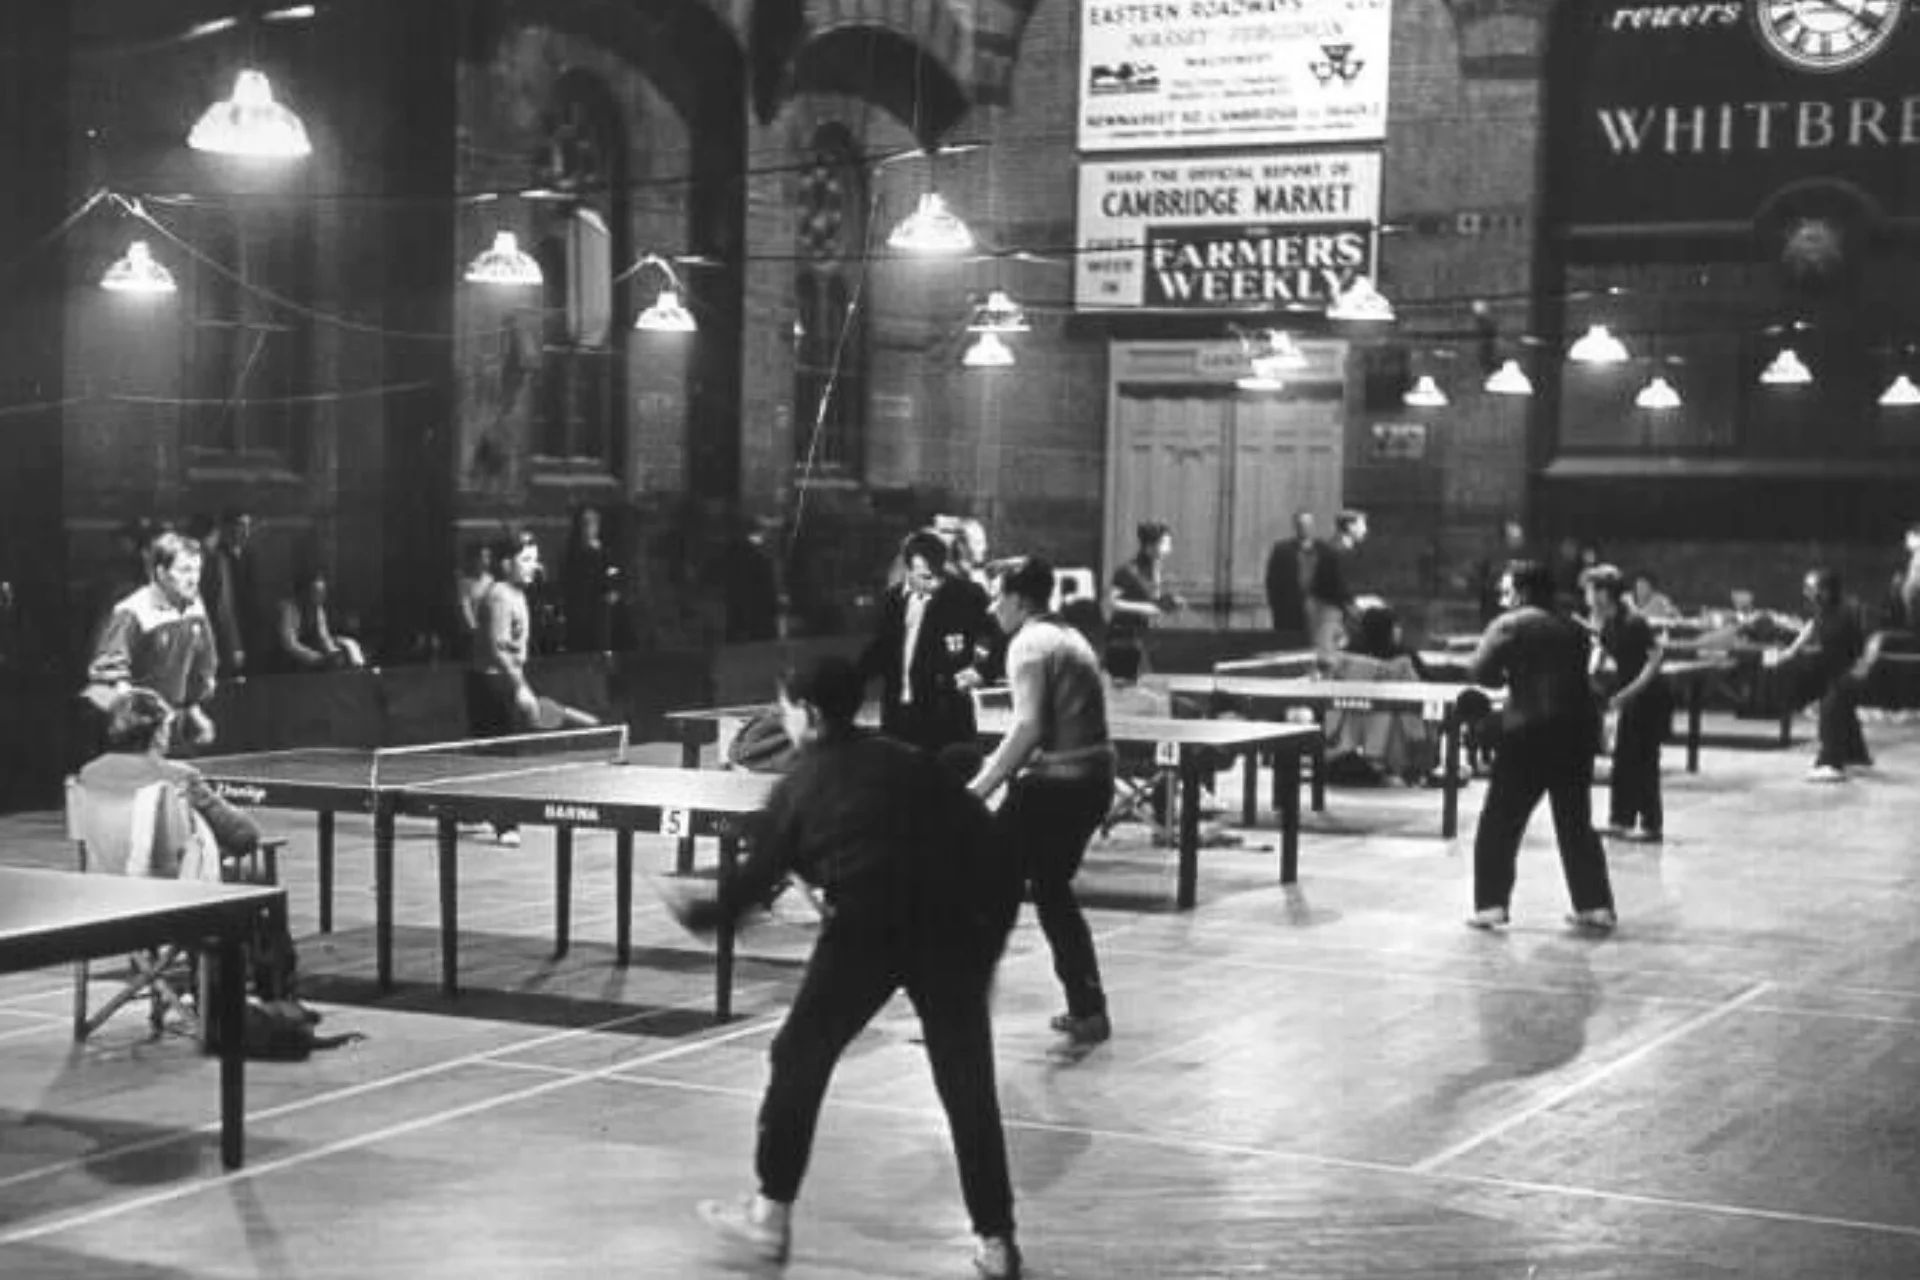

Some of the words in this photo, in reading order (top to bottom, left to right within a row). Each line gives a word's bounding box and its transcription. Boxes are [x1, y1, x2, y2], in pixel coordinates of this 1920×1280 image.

[1598, 97, 1920, 152] WHITBRE
[1102, 186, 1239, 218] CAMBRIDGE
[1253, 182, 1354, 215] MARKET
[1153, 232, 1366, 269] FARMERS
[1157, 266, 1354, 301] WEEKLY
[668, 811, 682, 834] 5
